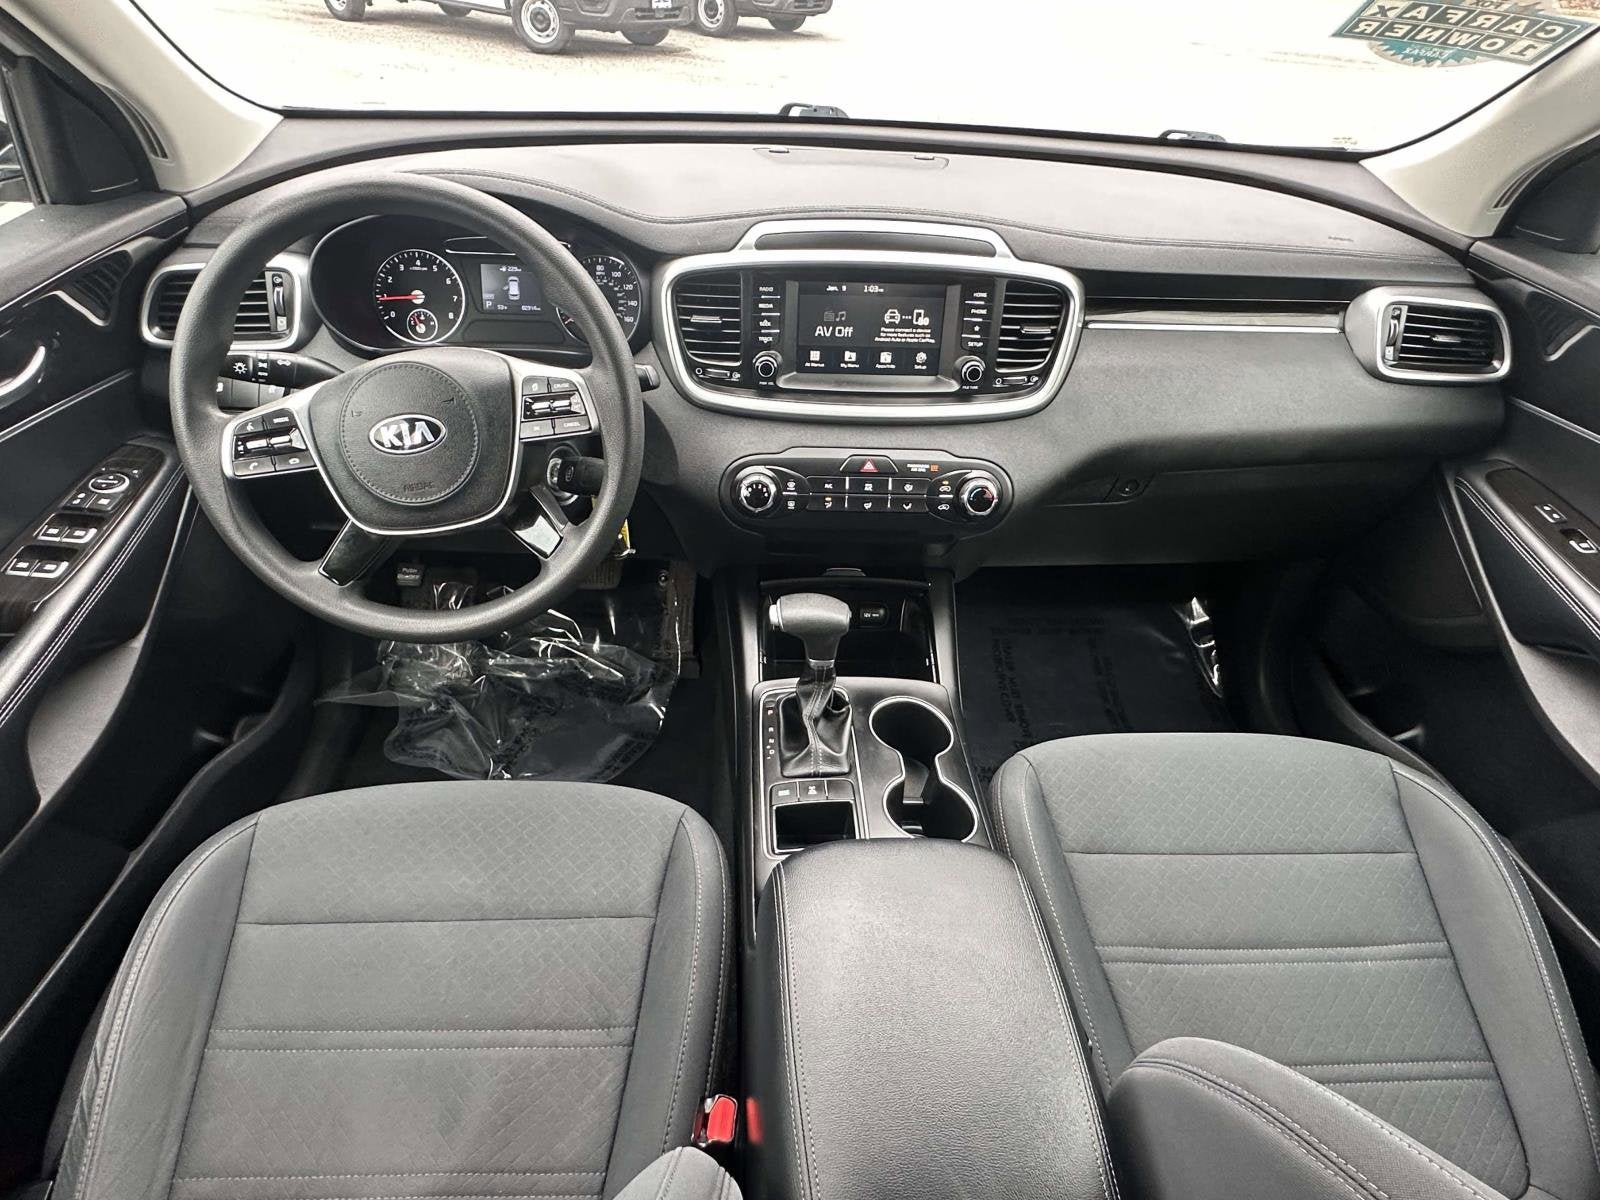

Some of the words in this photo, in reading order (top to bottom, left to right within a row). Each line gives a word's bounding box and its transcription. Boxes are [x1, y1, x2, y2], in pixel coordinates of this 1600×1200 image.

[815, 326, 832, 337] AV
[835, 326, 853, 337] Off
[380, 421, 435, 450] KIA
